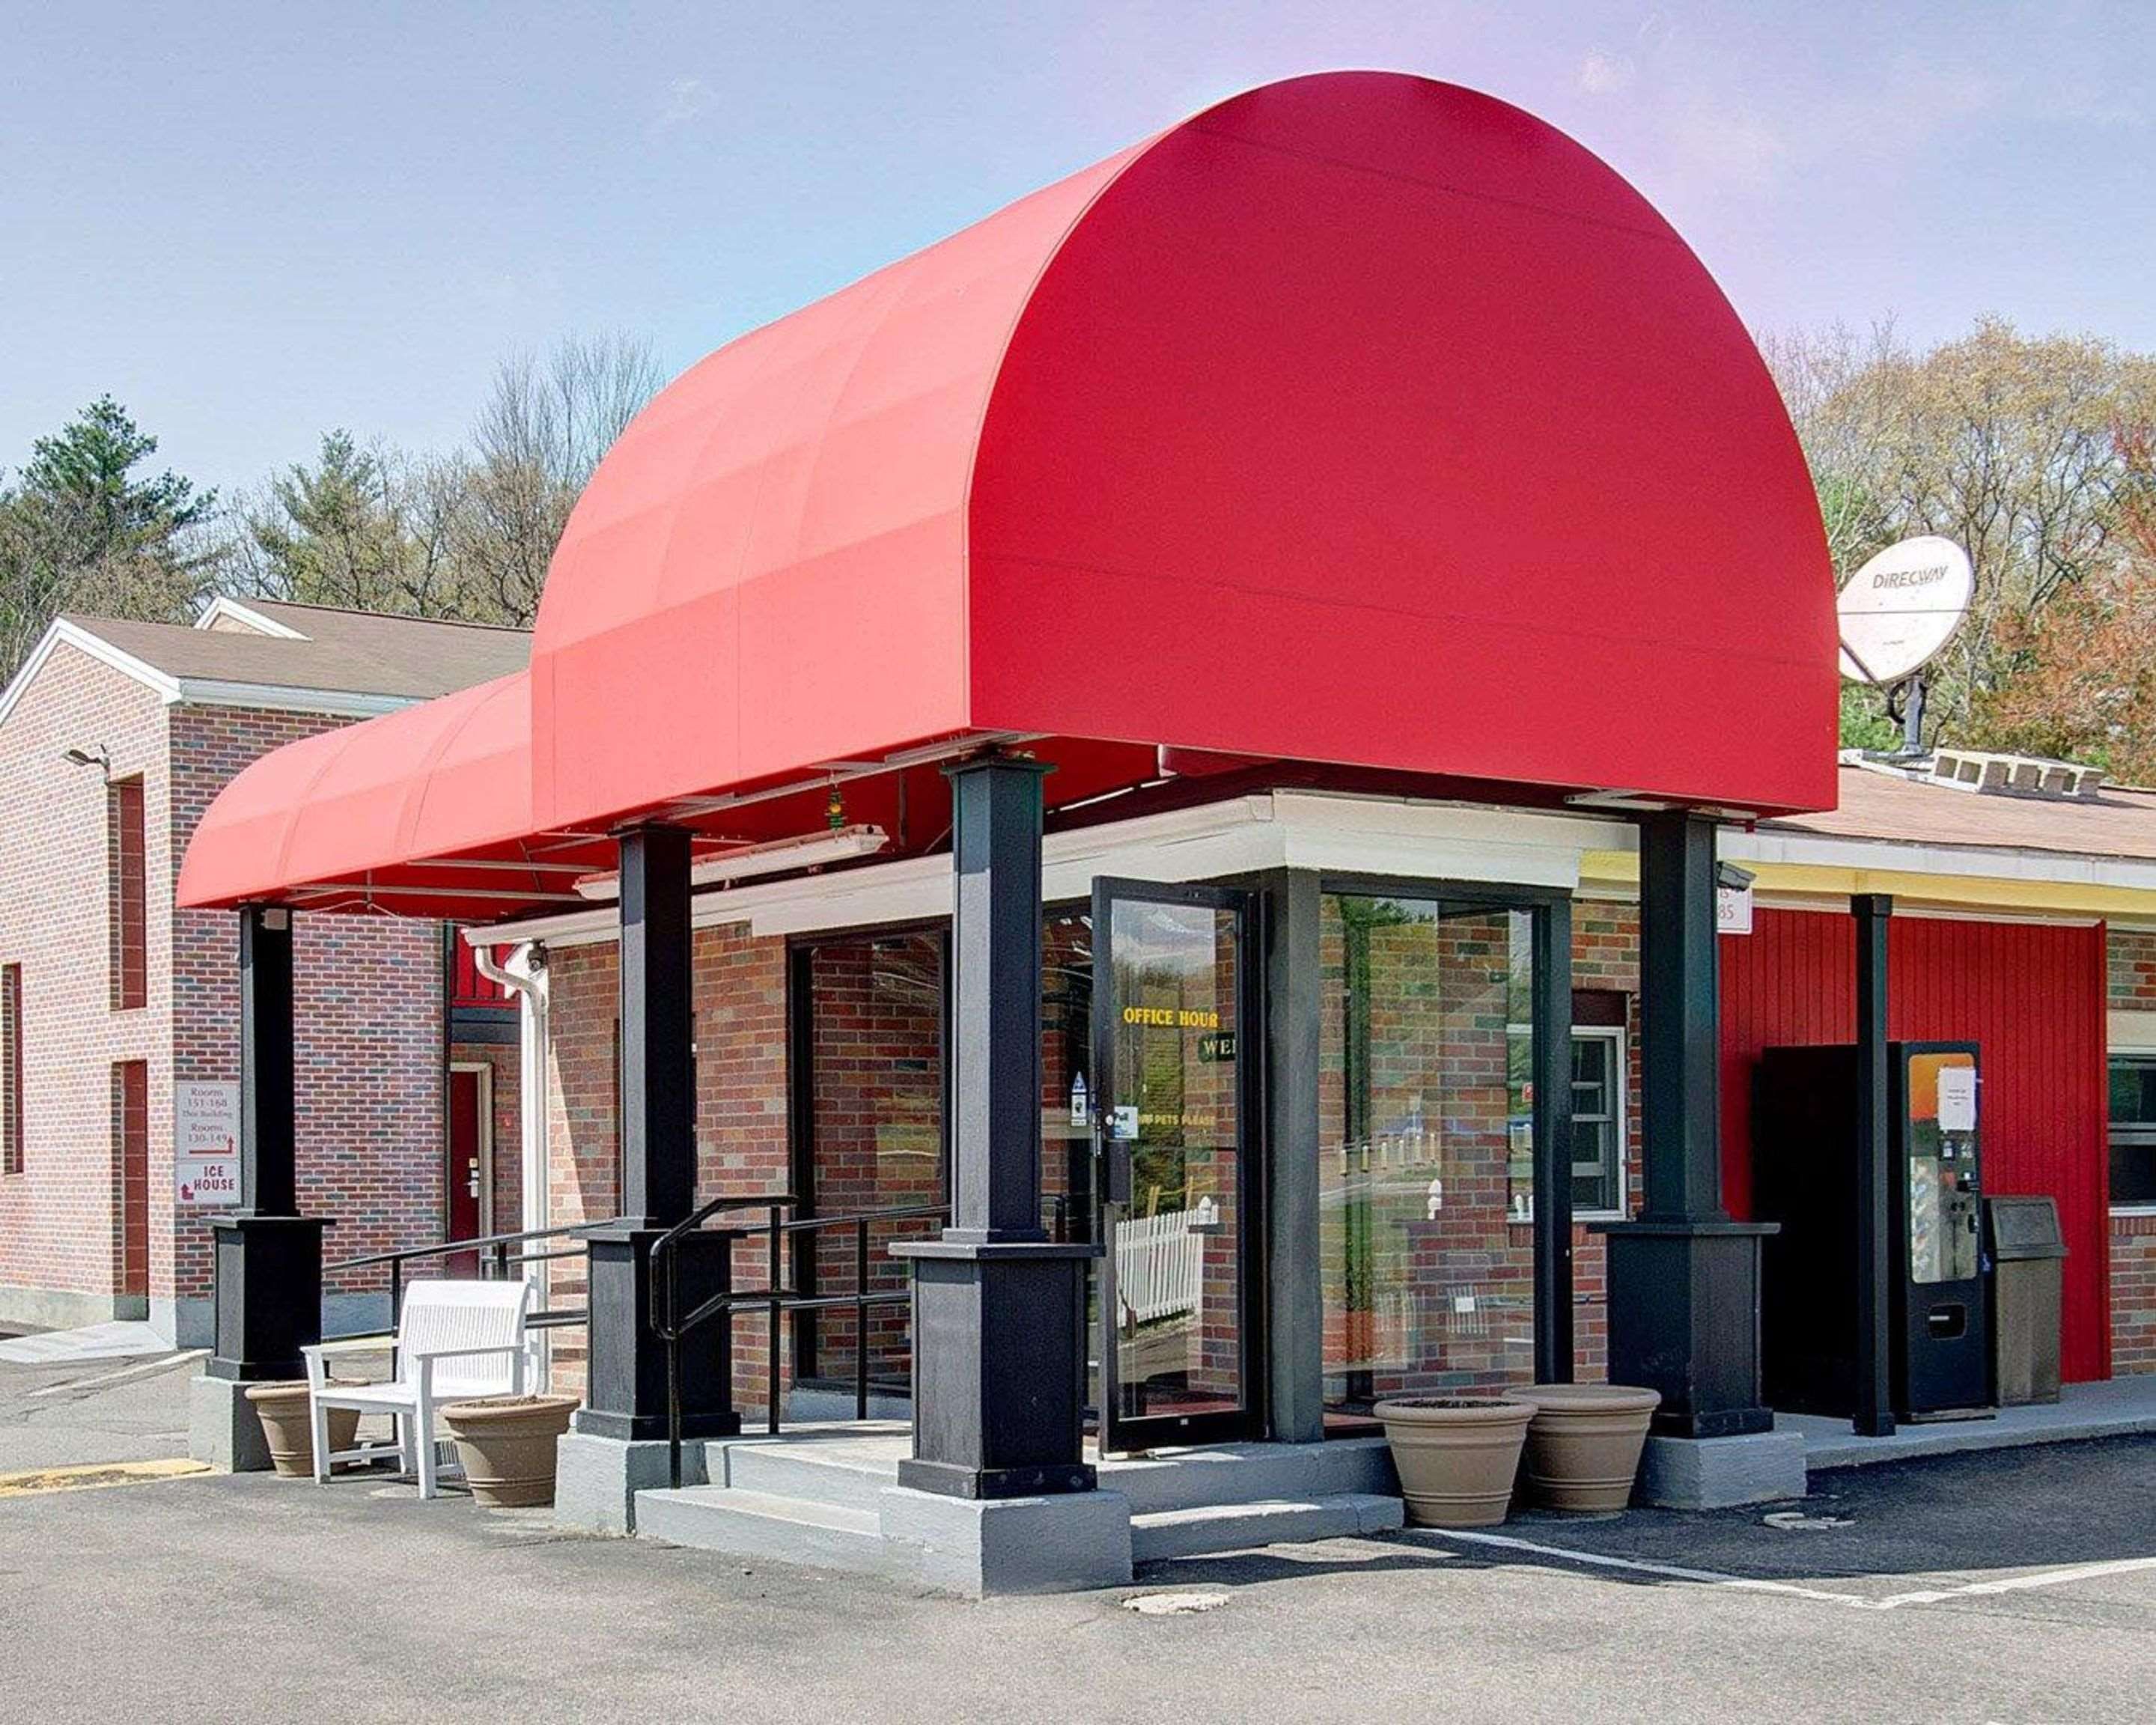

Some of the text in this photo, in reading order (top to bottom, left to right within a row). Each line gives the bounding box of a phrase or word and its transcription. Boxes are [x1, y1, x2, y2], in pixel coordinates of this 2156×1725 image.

[1124, 1007, 1174, 1025] OFFICE
[204, 1165, 224, 1178] ICE
[194, 1178, 234, 1190] HOUSE
